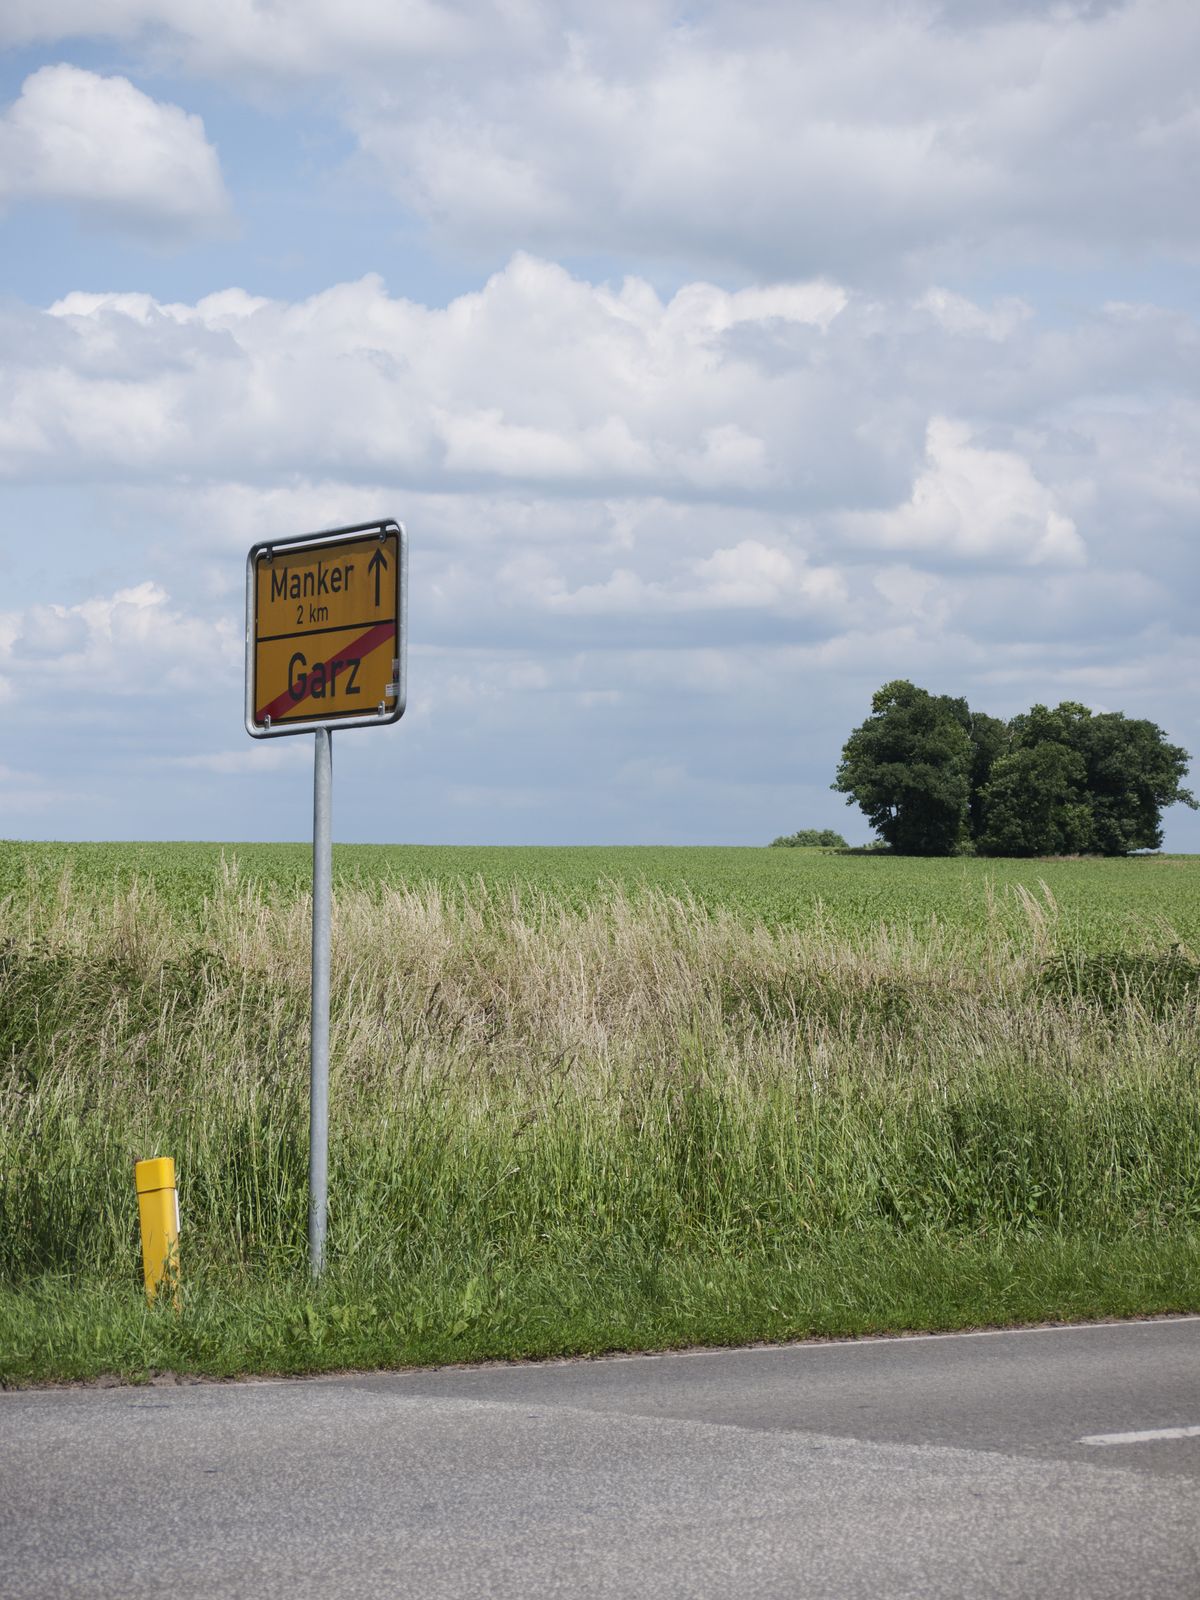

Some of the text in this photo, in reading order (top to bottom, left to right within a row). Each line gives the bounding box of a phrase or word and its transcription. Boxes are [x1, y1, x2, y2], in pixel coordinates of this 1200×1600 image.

[271, 561, 355, 602] Manker
[296, 603, 329, 625] 2 km
[288, 652, 361, 701] Garz
